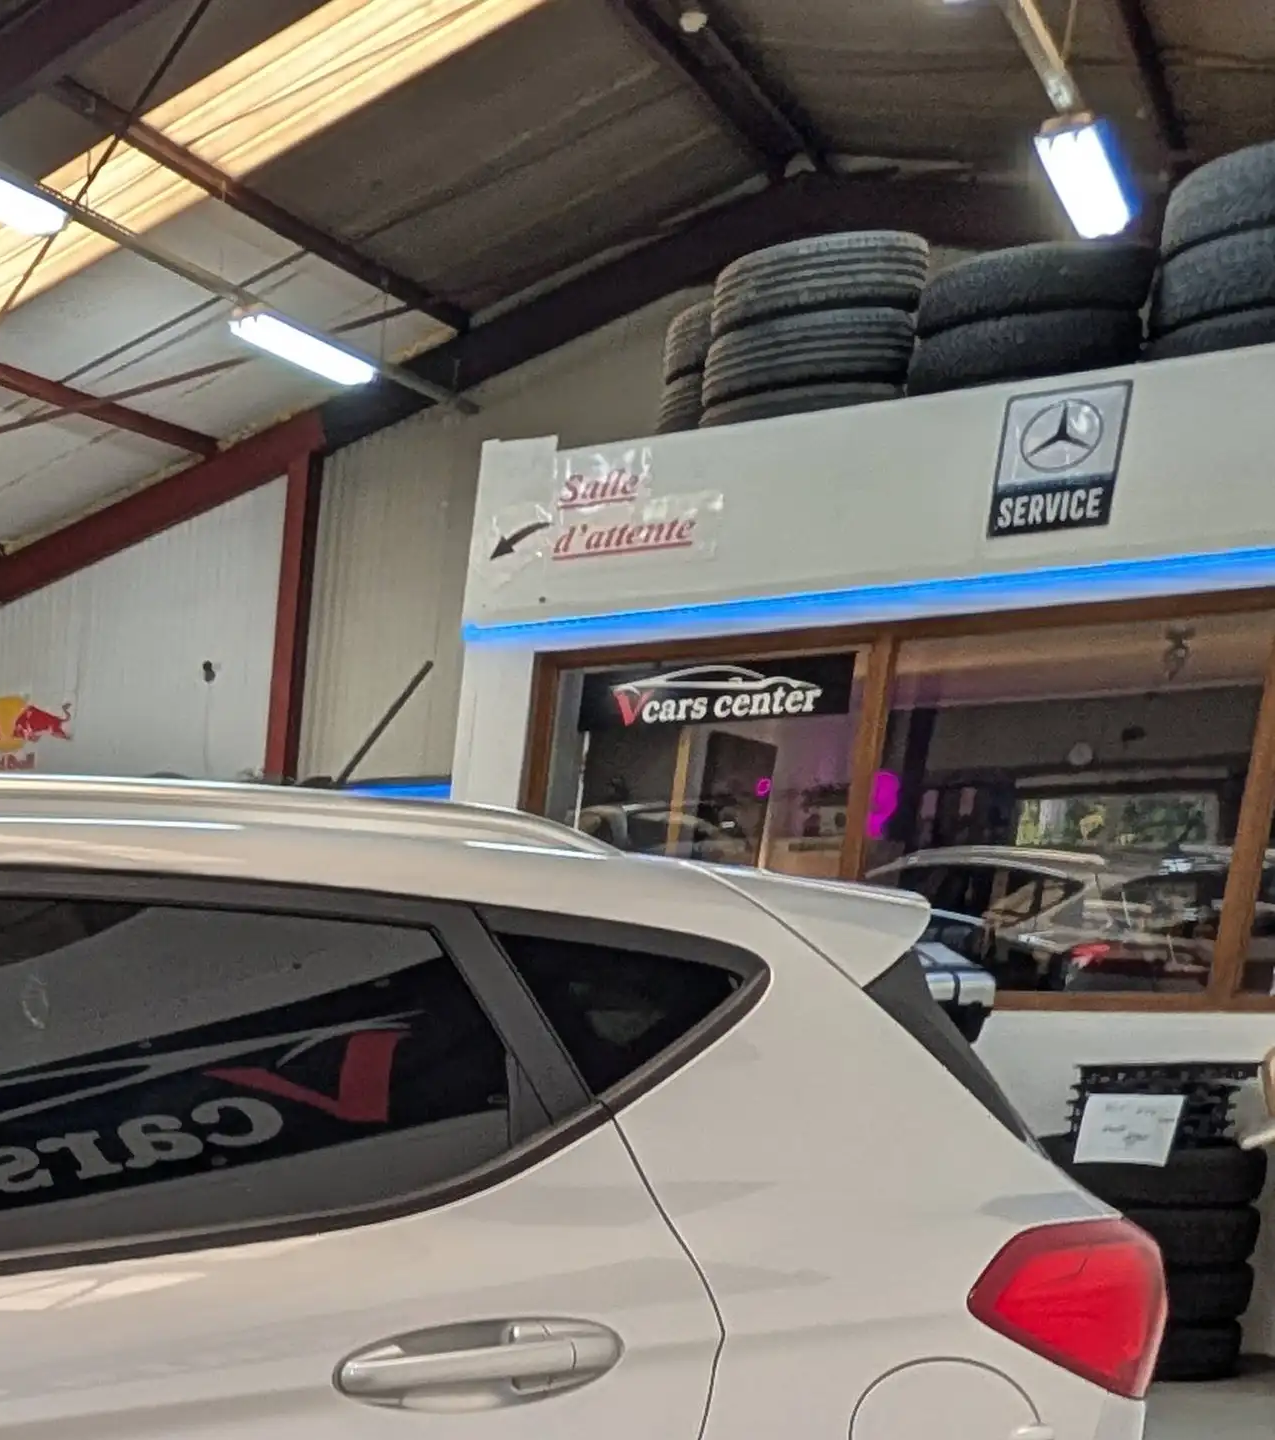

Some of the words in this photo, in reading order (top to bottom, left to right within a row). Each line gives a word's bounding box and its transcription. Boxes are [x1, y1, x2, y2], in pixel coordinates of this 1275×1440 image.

[558, 467, 640, 502] Salle
[997, 486, 1105, 529] SERVICE
[552, 518, 696, 555] d'attente
[713, 686, 824, 718] center
